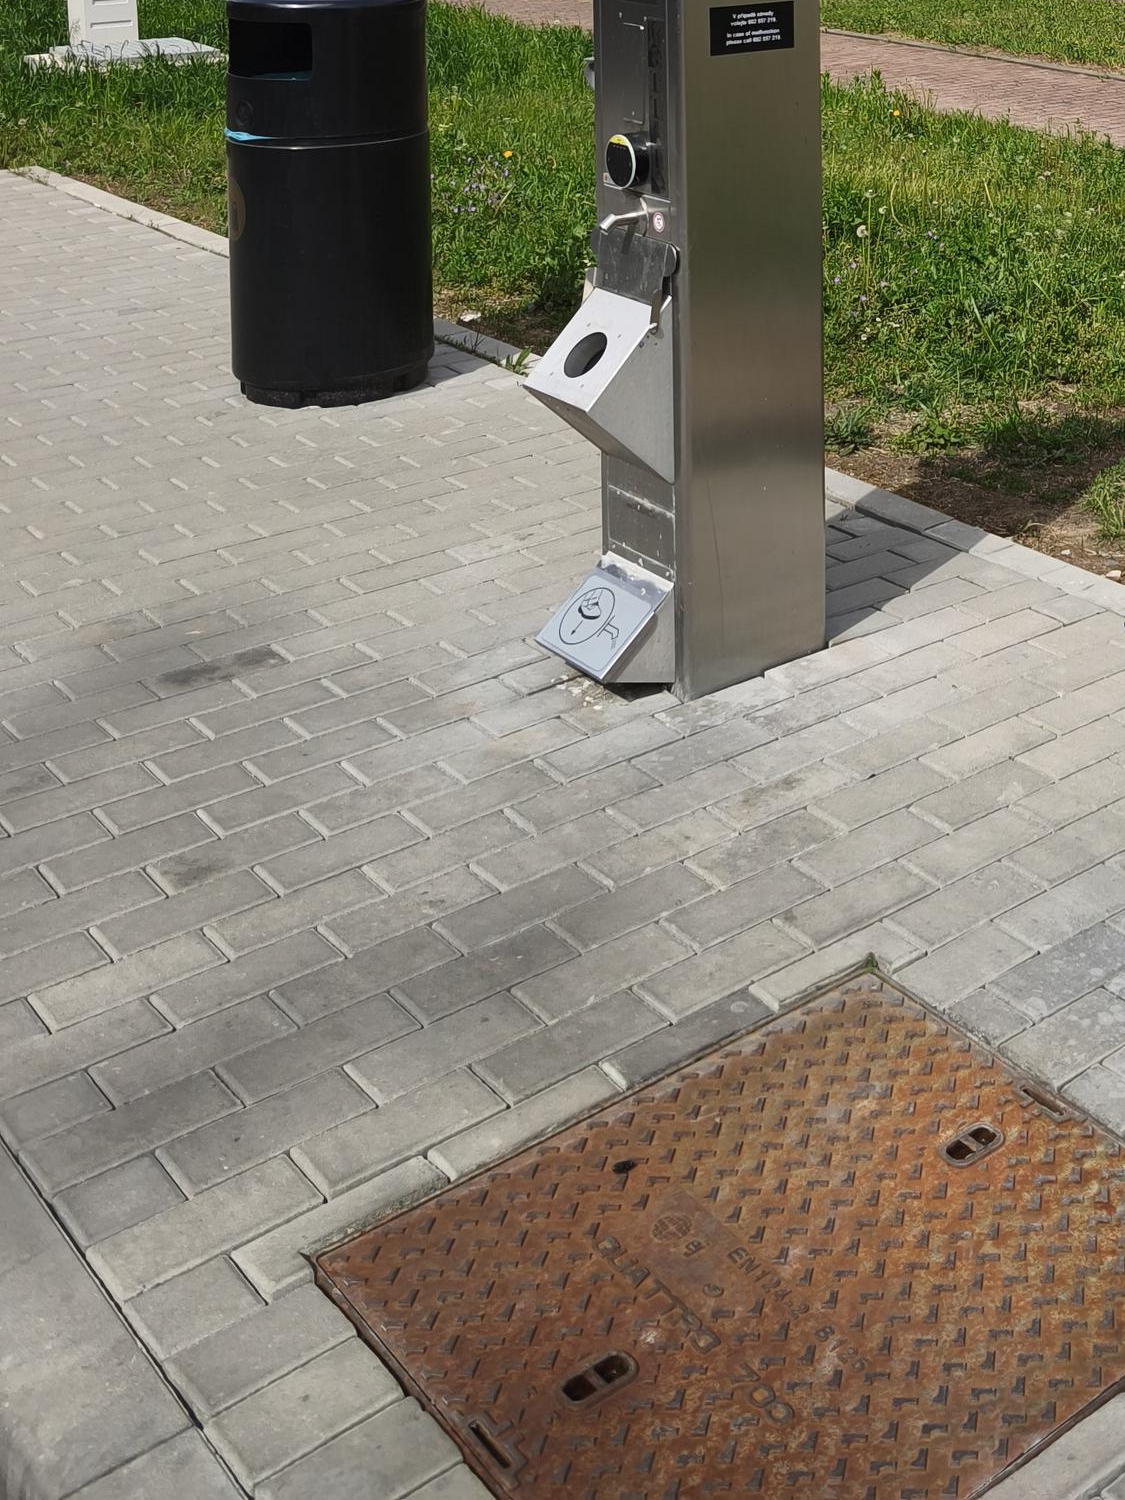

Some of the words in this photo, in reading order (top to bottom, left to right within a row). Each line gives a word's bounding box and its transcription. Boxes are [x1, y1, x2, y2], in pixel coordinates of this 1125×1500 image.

[726, 39, 742, 47] please
[592, 1233, 722, 1355] QUATTRO
[732, 1362, 797, 1425] 700
